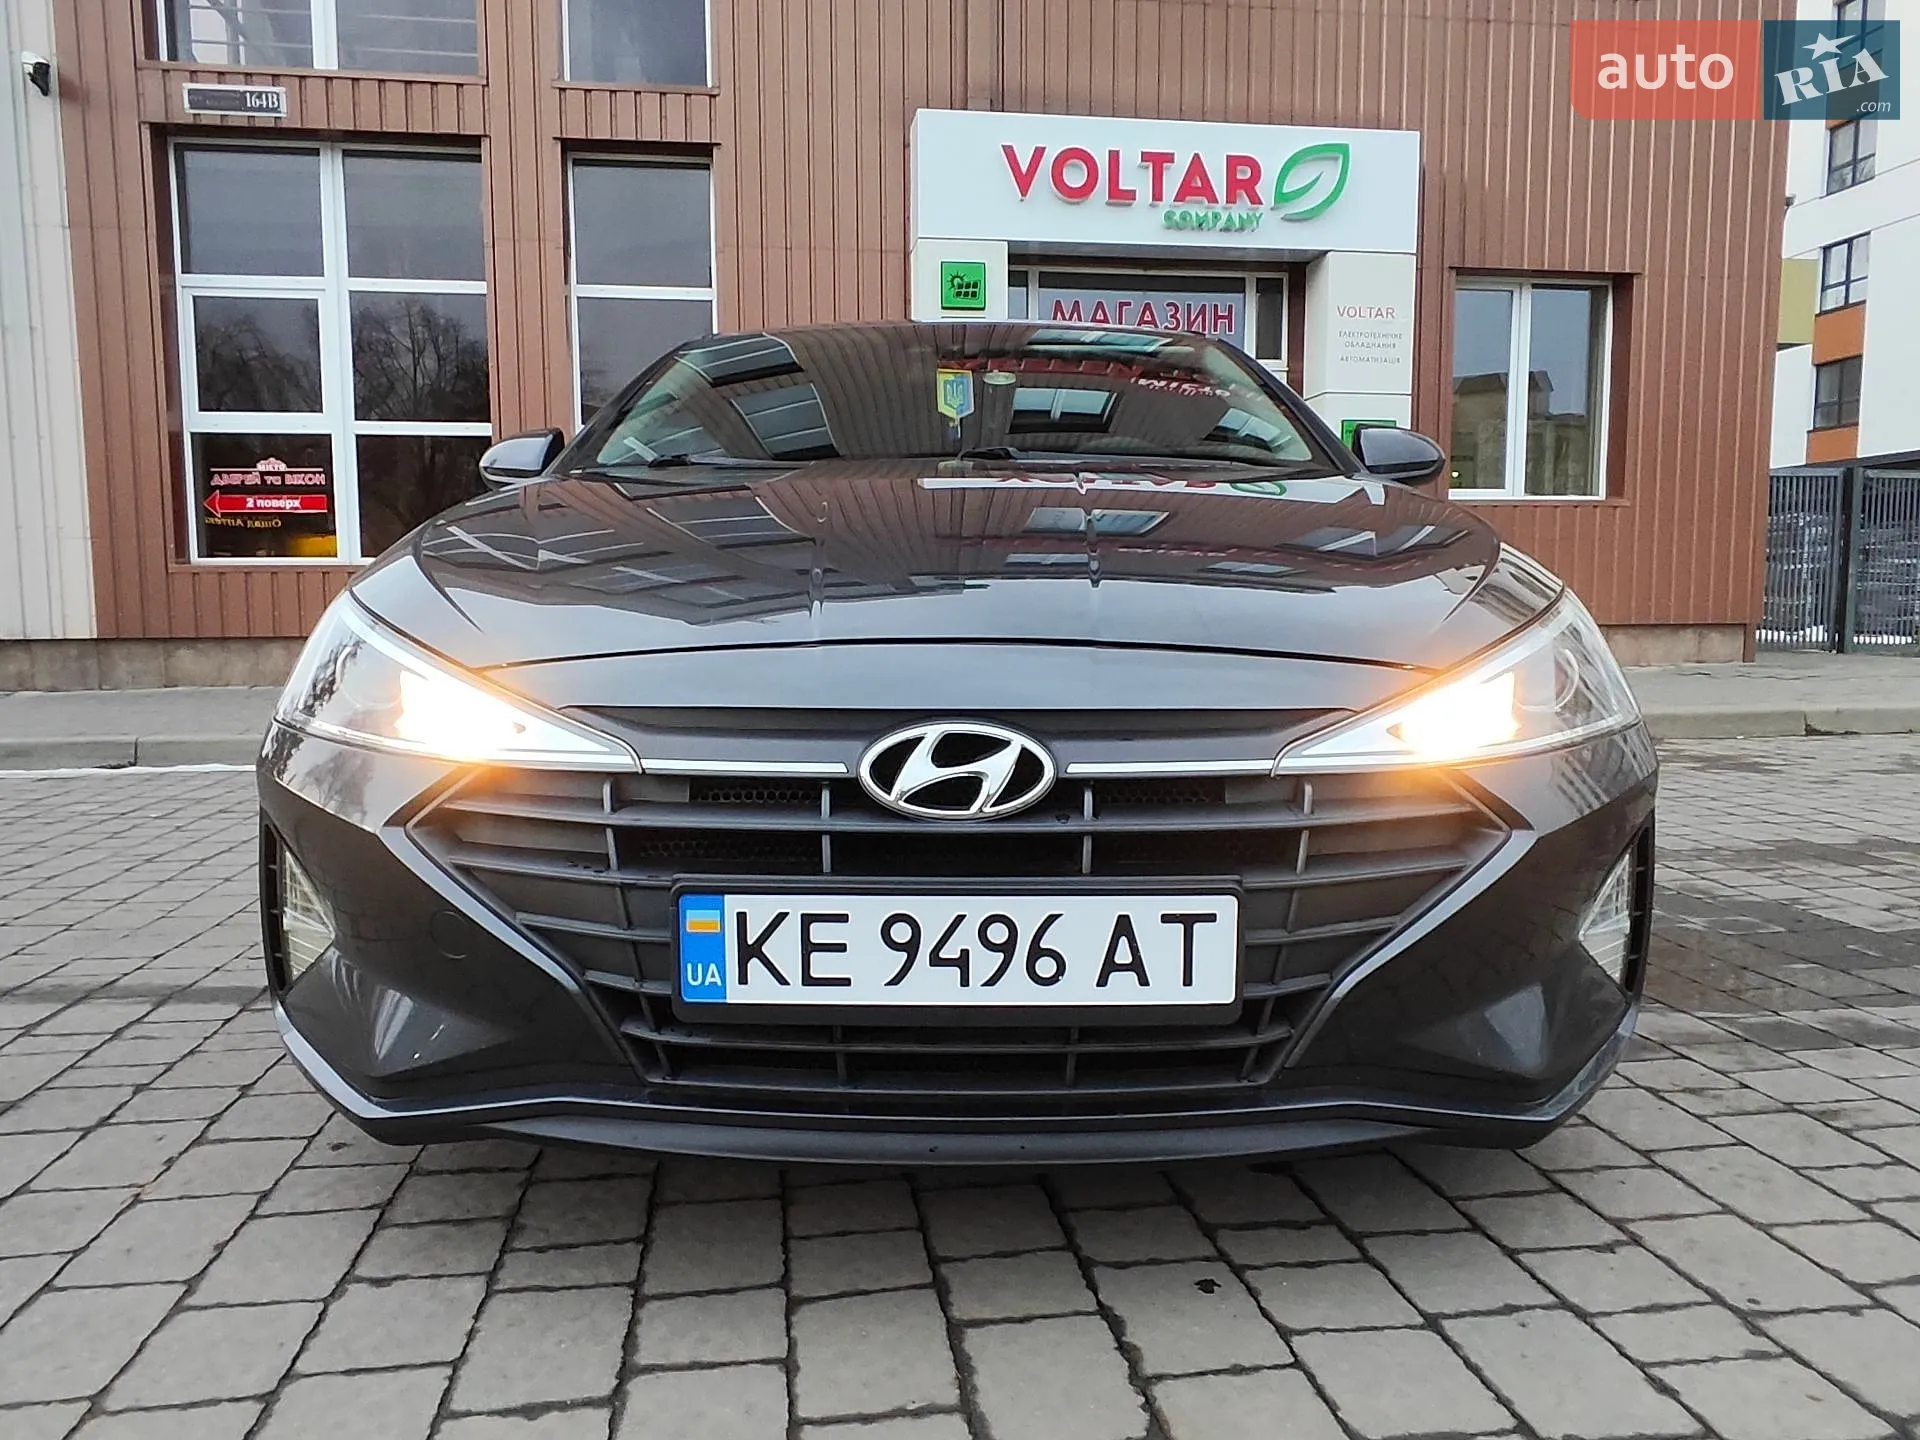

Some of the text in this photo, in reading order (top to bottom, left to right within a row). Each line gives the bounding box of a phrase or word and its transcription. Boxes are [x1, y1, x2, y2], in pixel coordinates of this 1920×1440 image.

[1001, 144, 1264, 206] VOLTAR
[1163, 210, 1264, 233] COMPANY
[1052, 299, 1235, 335] МАГАЗИН
[1337, 305, 1396, 319] VOLTAR
[246, 497, 302, 510] 2 поверх
[736, 911, 1218, 988] KE 9496 AT
[687, 963, 722, 986] UA
